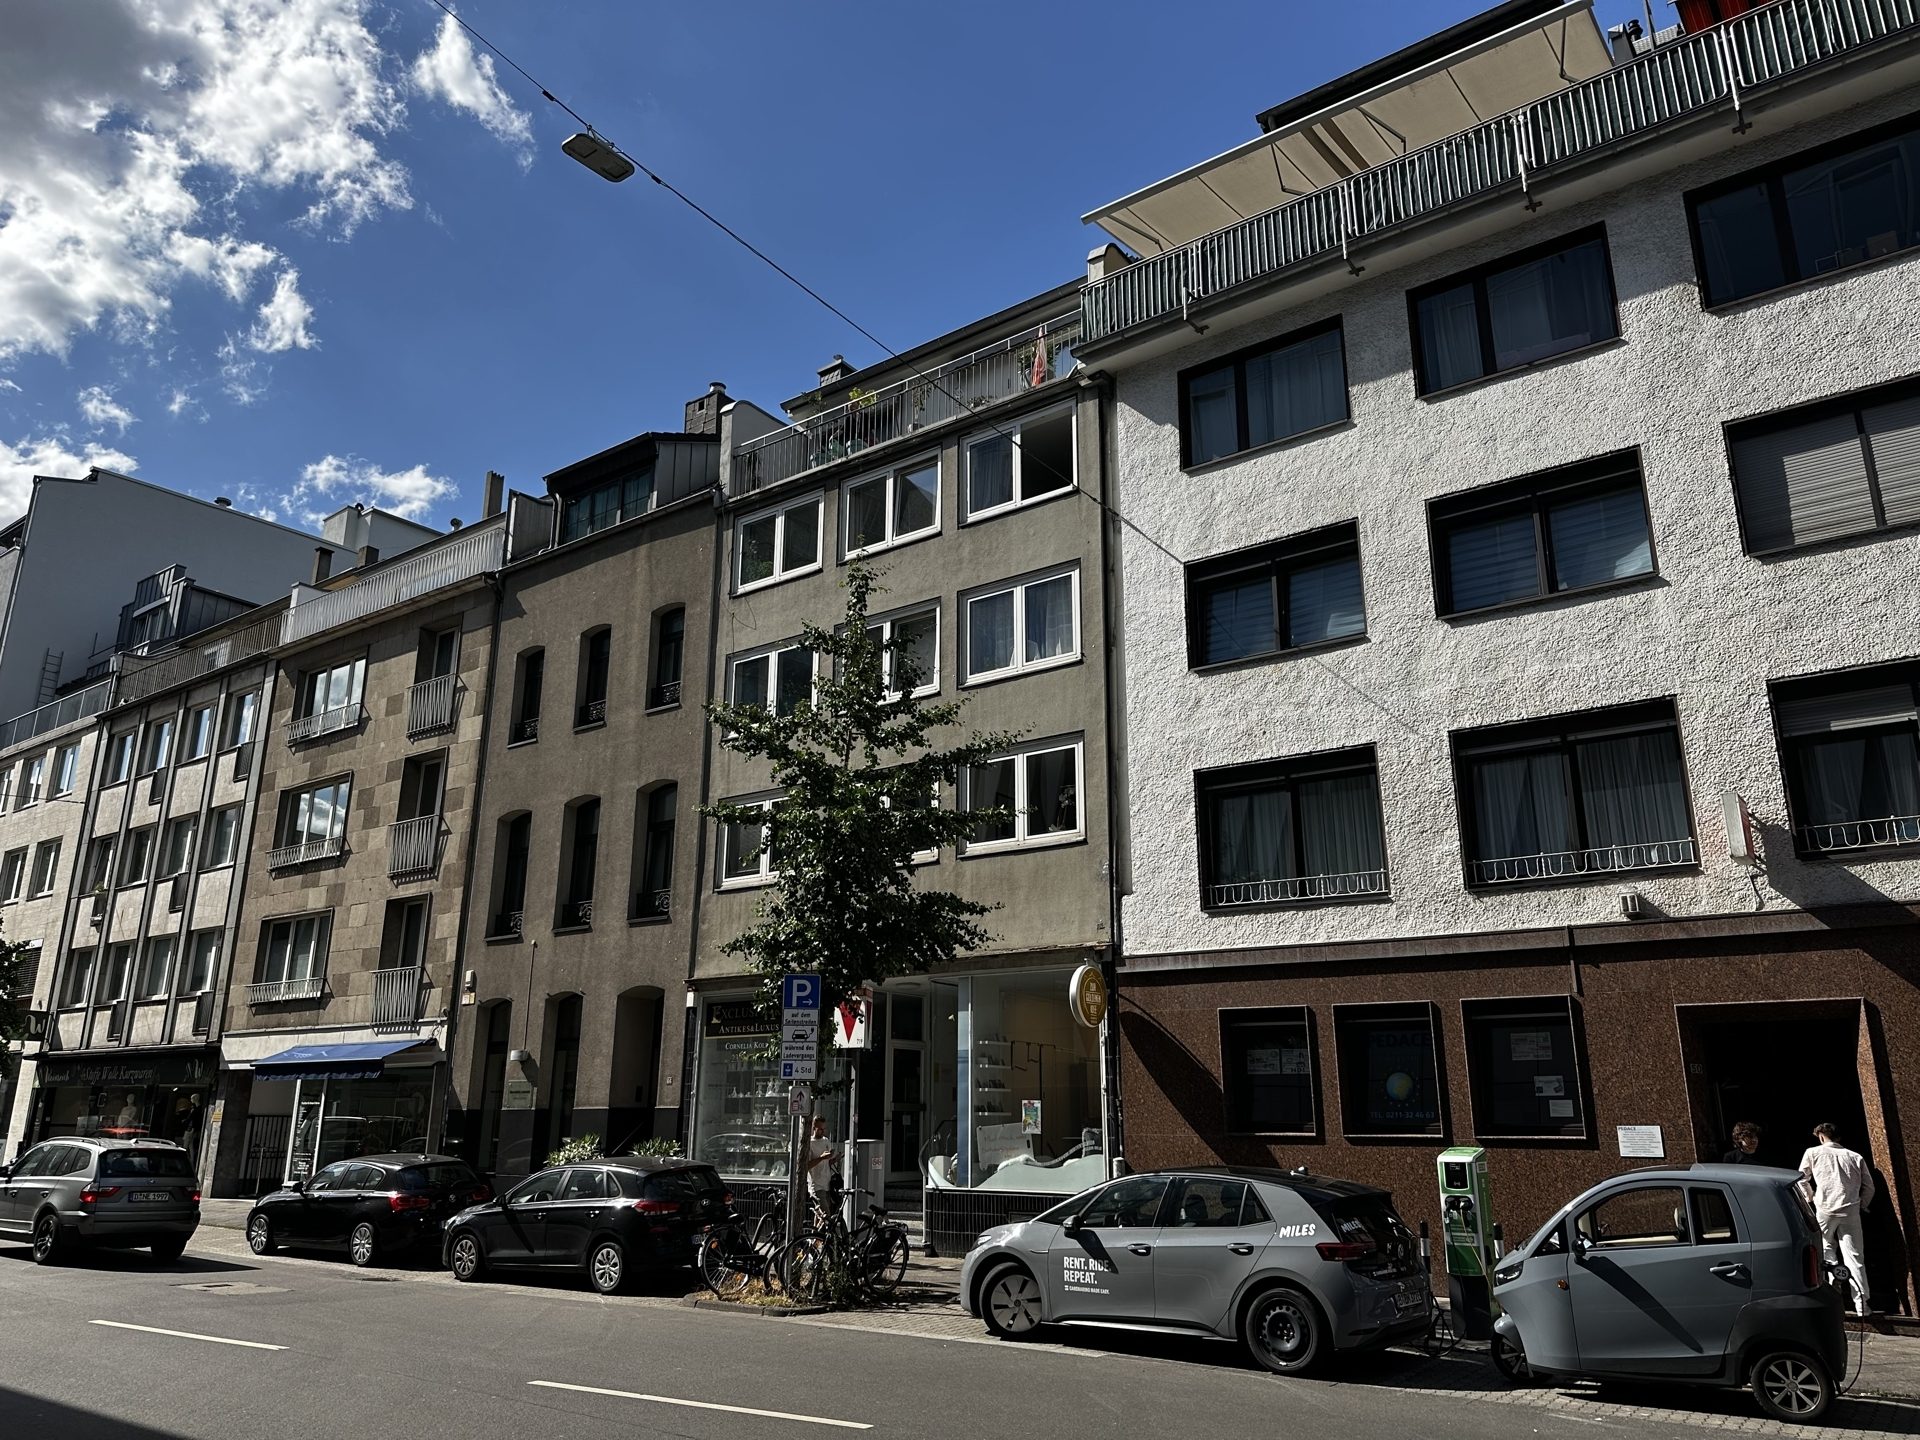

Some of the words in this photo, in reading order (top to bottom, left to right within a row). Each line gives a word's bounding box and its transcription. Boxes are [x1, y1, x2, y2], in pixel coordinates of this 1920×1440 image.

[791, 979, 812, 1007] P
[725, 1042, 753, 1050] CORNELIA
[1279, 1223, 1316, 1238] MILES
[1063, 1256, 1088, 1270] RENT.
[1088, 1258, 1112, 1272] RIDE.
[1063, 1270, 1098, 1284] REPEAT.
[1836, 1268, 1847, 1278] 25
